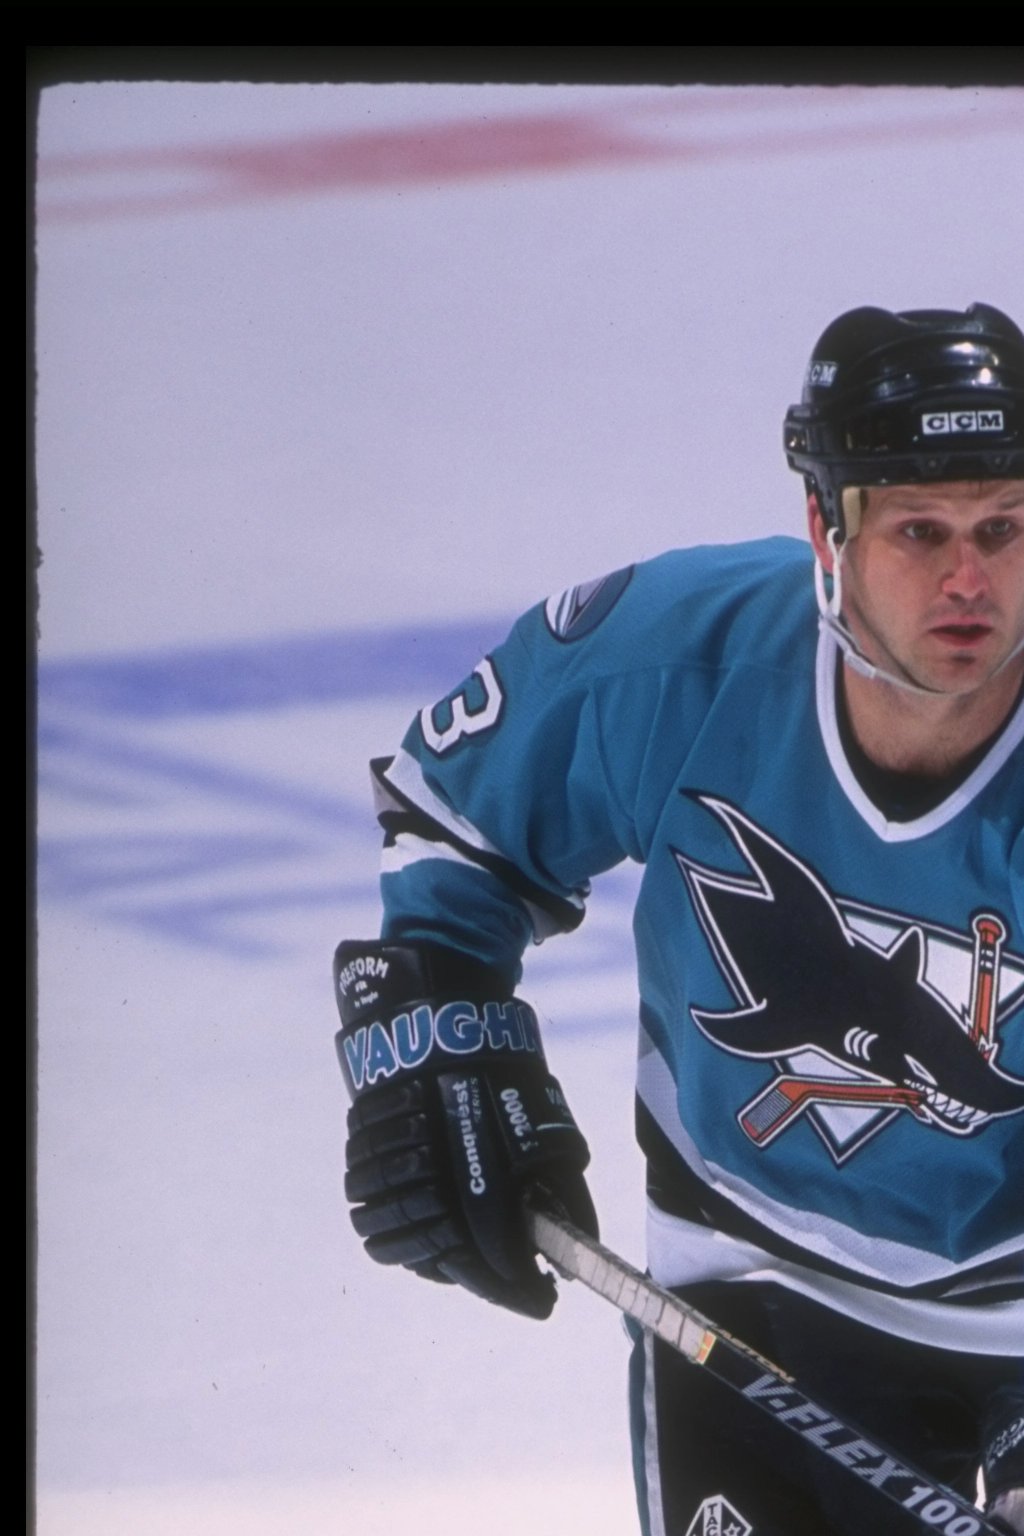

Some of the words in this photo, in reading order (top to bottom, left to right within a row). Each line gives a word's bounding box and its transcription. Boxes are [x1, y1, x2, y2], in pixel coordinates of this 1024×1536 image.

[809, 363, 837, 383] CM
[926, 411, 1002, 433] CCM
[500, 1087, 532, 1137] 2000
[452, 1080, 486, 1195] Conquest
[741, 1373, 915, 1489] V-FLEX
